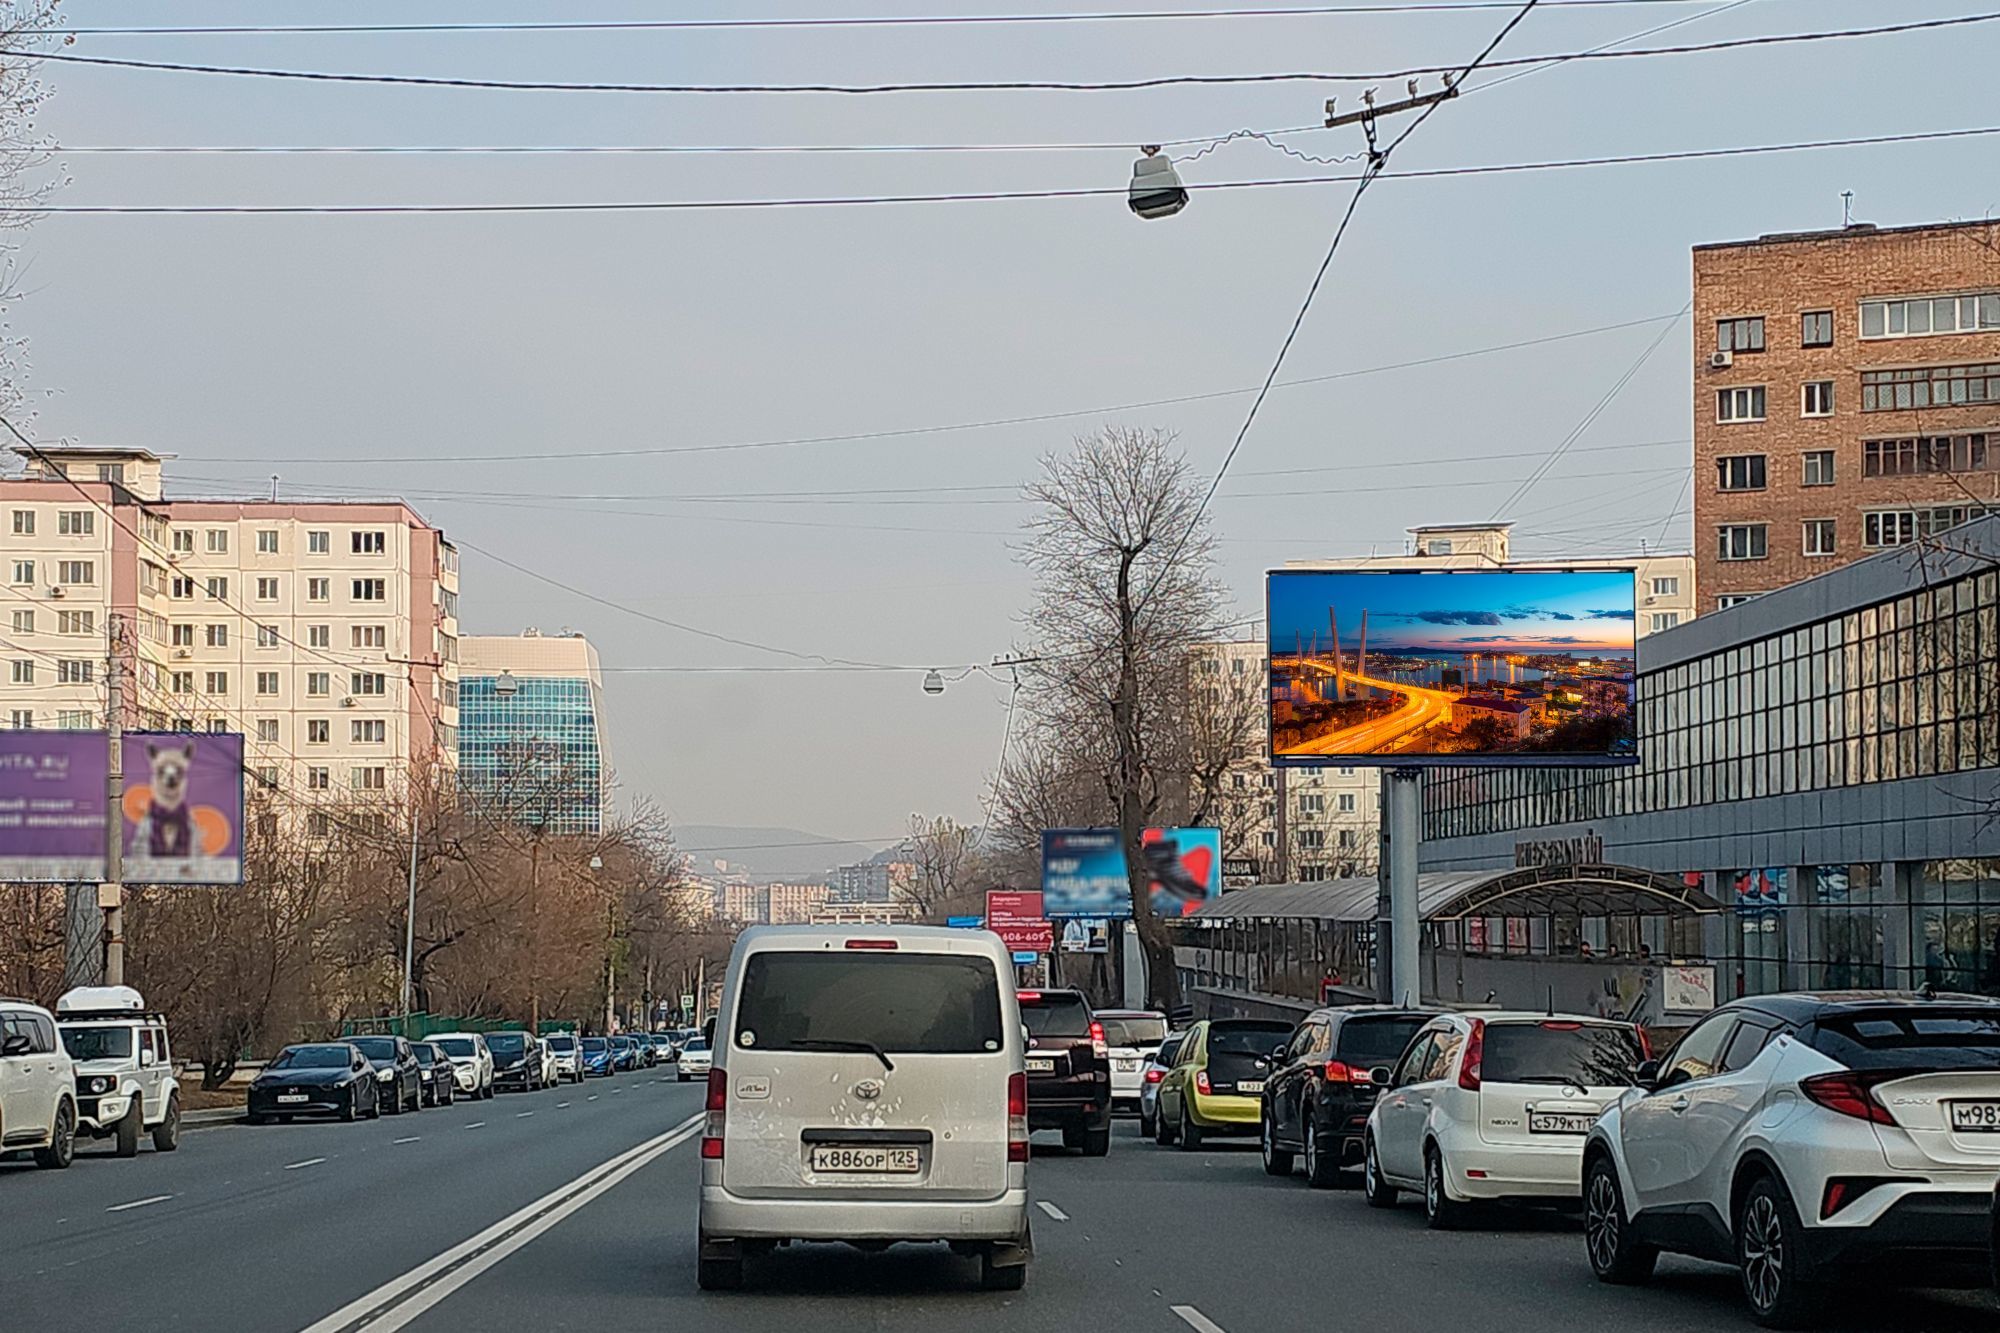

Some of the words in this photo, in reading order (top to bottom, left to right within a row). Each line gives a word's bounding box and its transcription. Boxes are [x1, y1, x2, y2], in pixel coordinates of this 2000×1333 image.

[1003, 932, 1045, 941] 606-609
[1957, 1105, 2000, 1125] М98
[819, 1151, 885, 1168] К886ОР
[889, 1150, 914, 1164] 125
